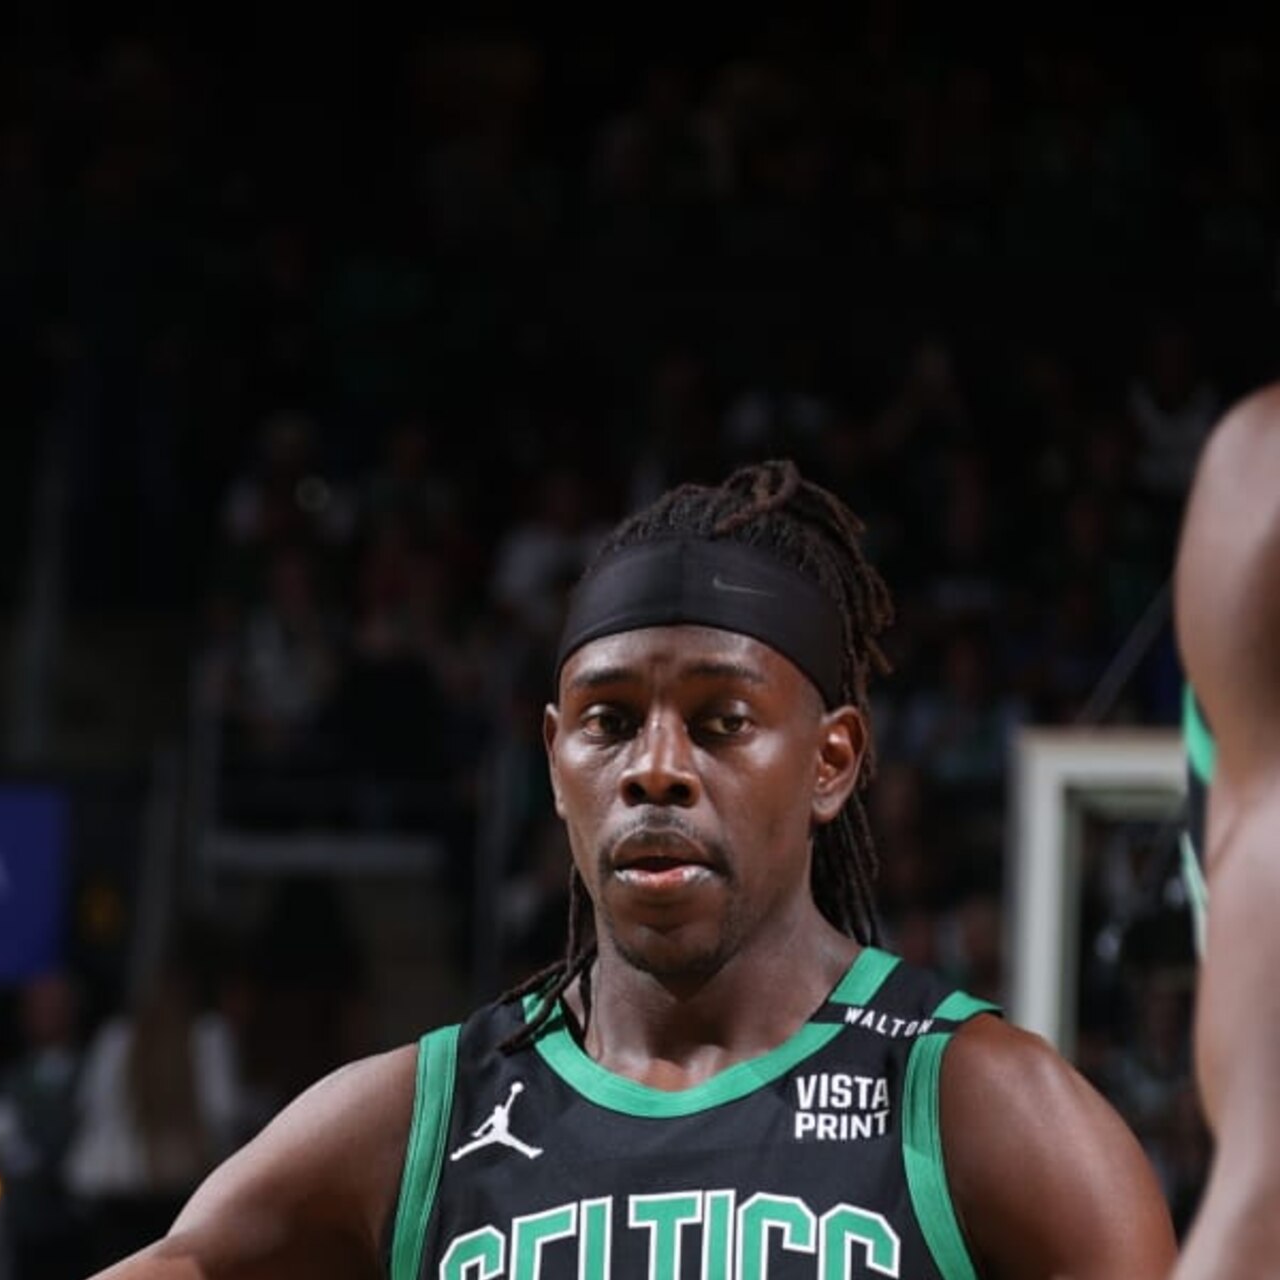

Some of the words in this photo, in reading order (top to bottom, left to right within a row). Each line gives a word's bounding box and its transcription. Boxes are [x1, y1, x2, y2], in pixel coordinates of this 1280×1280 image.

[844, 1006, 933, 1038] WALTON
[796, 1073, 890, 1110] VISTA
[794, 1109, 890, 1141] PRINT
